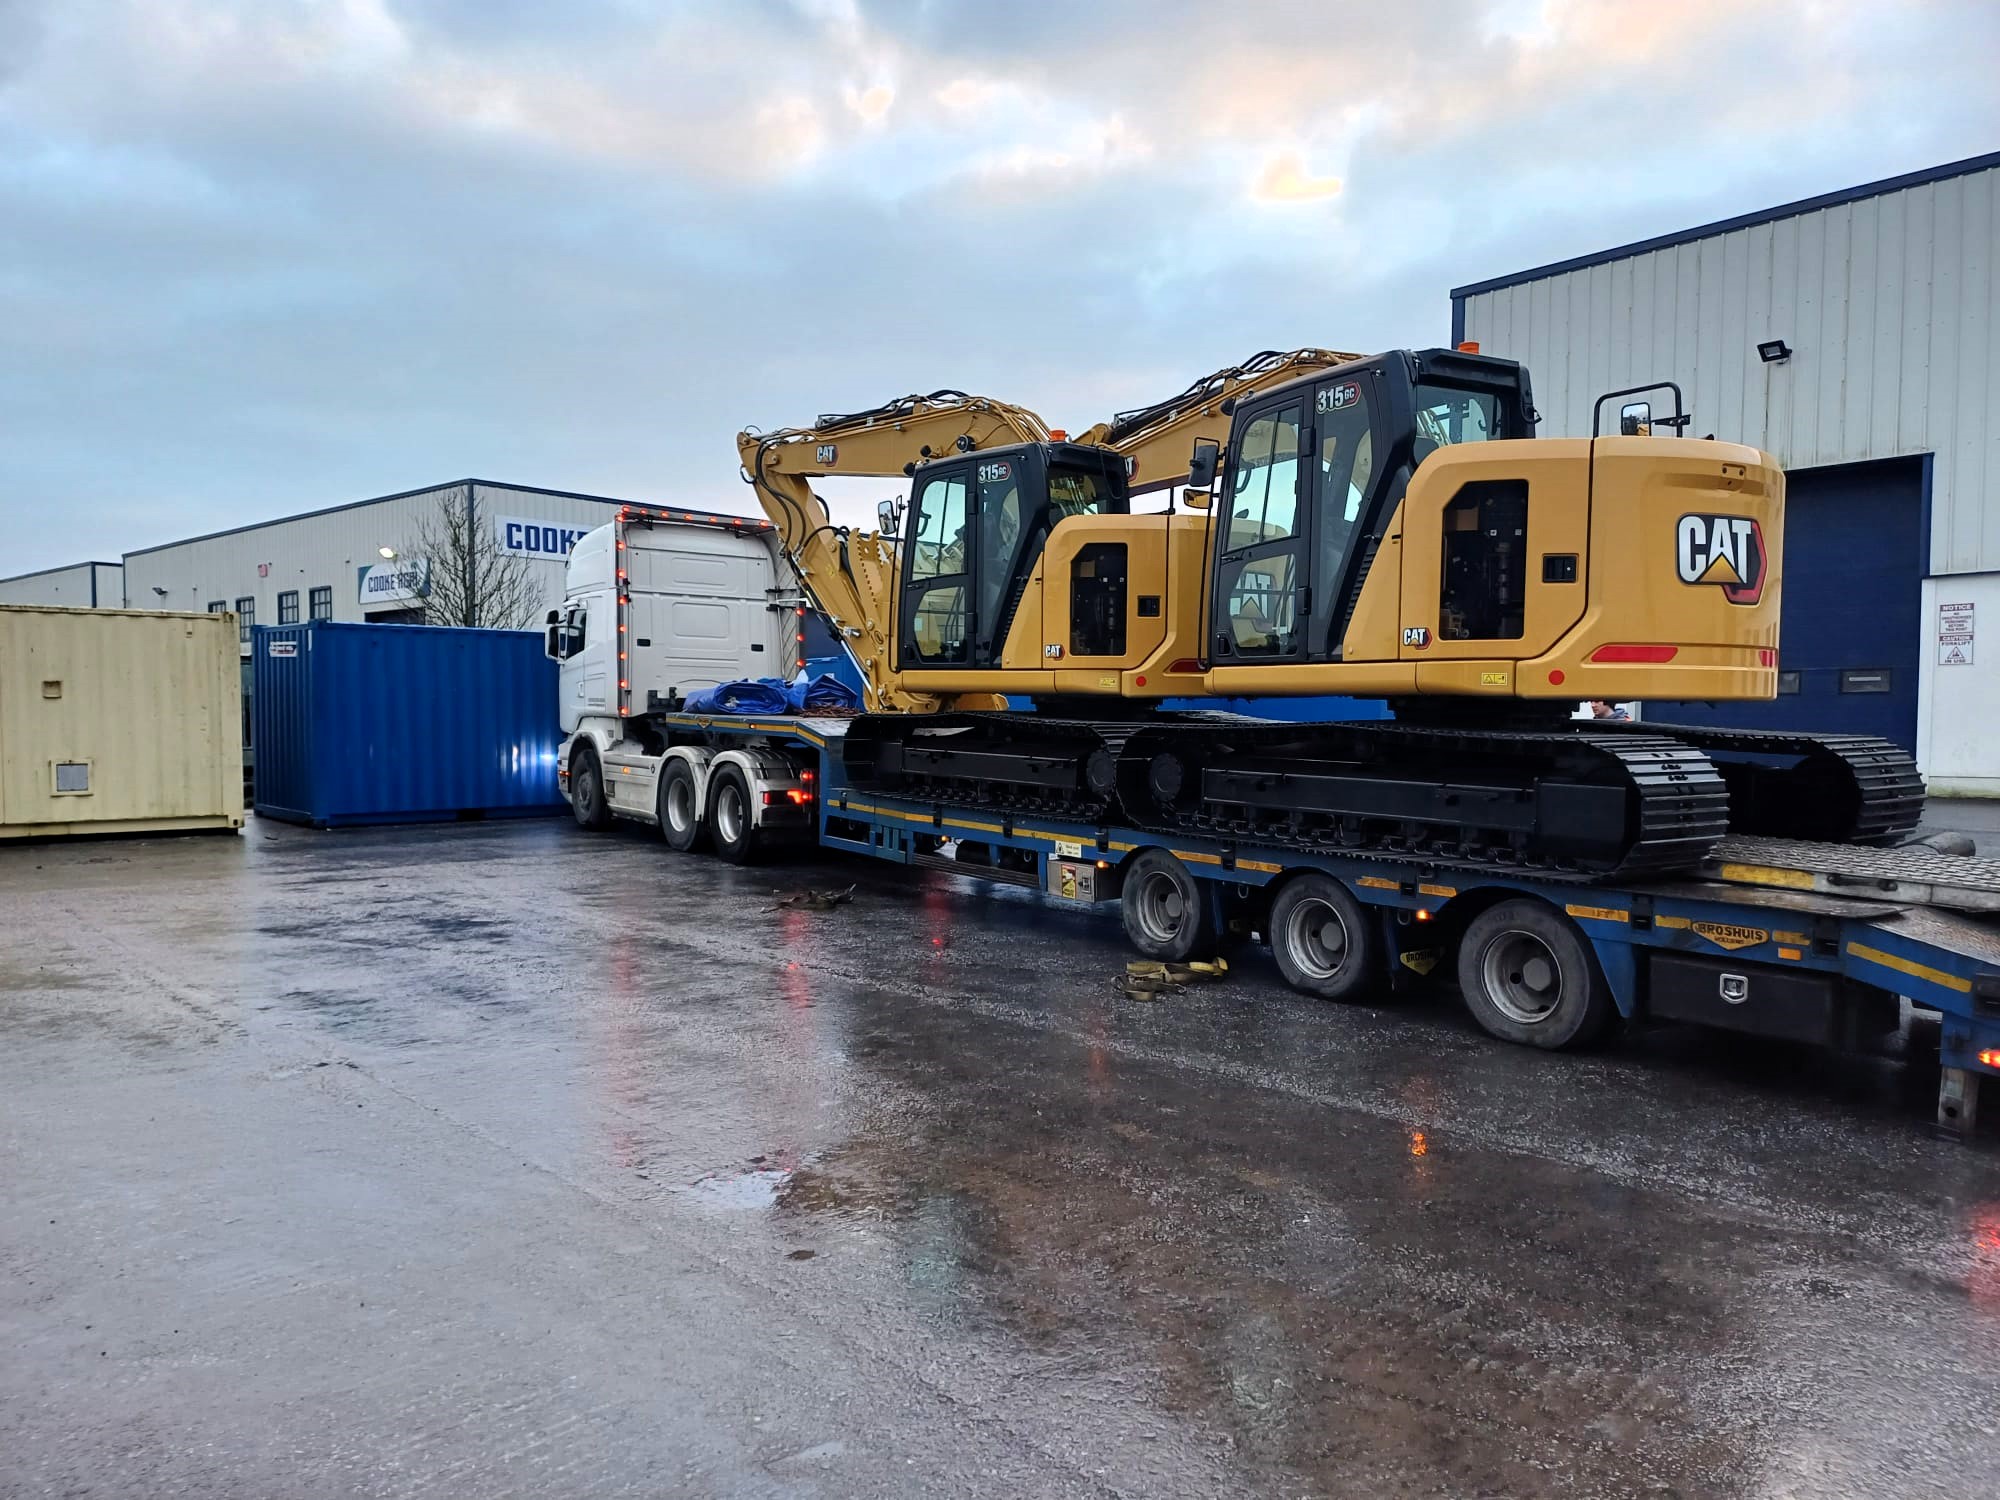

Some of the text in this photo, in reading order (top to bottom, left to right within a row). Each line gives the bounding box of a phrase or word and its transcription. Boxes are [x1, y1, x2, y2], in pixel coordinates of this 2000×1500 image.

[1318, 386, 1355, 411] 315 GC
[816, 446, 834, 463] CAT
[979, 464, 999, 481] 315
[506, 523, 588, 555] COOK
[1679, 516, 1752, 584] CAT
[368, 574, 395, 593] COOKE
[1403, 628, 1426, 646] CAT
[1045, 645, 1061, 658] CAT
[1698, 923, 1764, 941] BROSHUIS
